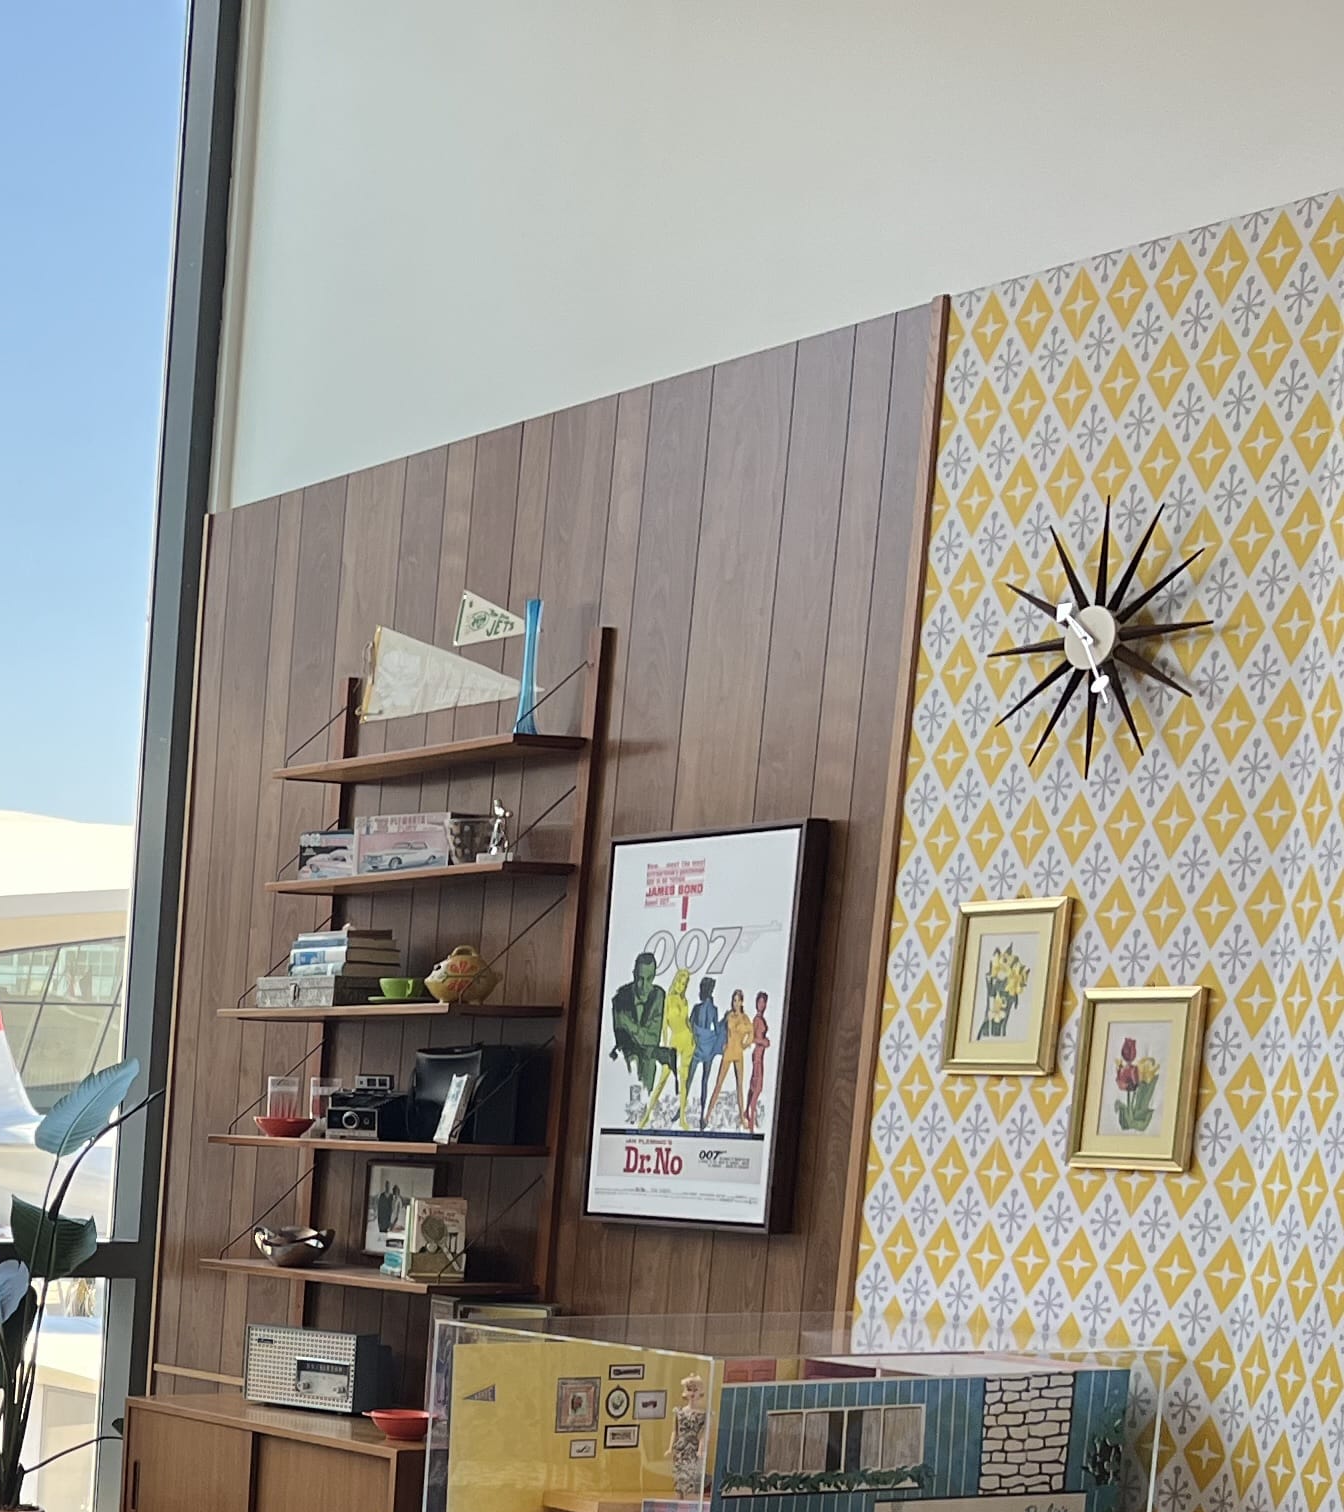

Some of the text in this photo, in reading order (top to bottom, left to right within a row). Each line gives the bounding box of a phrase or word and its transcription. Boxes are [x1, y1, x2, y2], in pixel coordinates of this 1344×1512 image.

[486, 619, 515, 637] JETS
[646, 884, 703, 897] JAMES BOND
[644, 926, 743, 976] 007
[698, 1150, 722, 1160] 007
